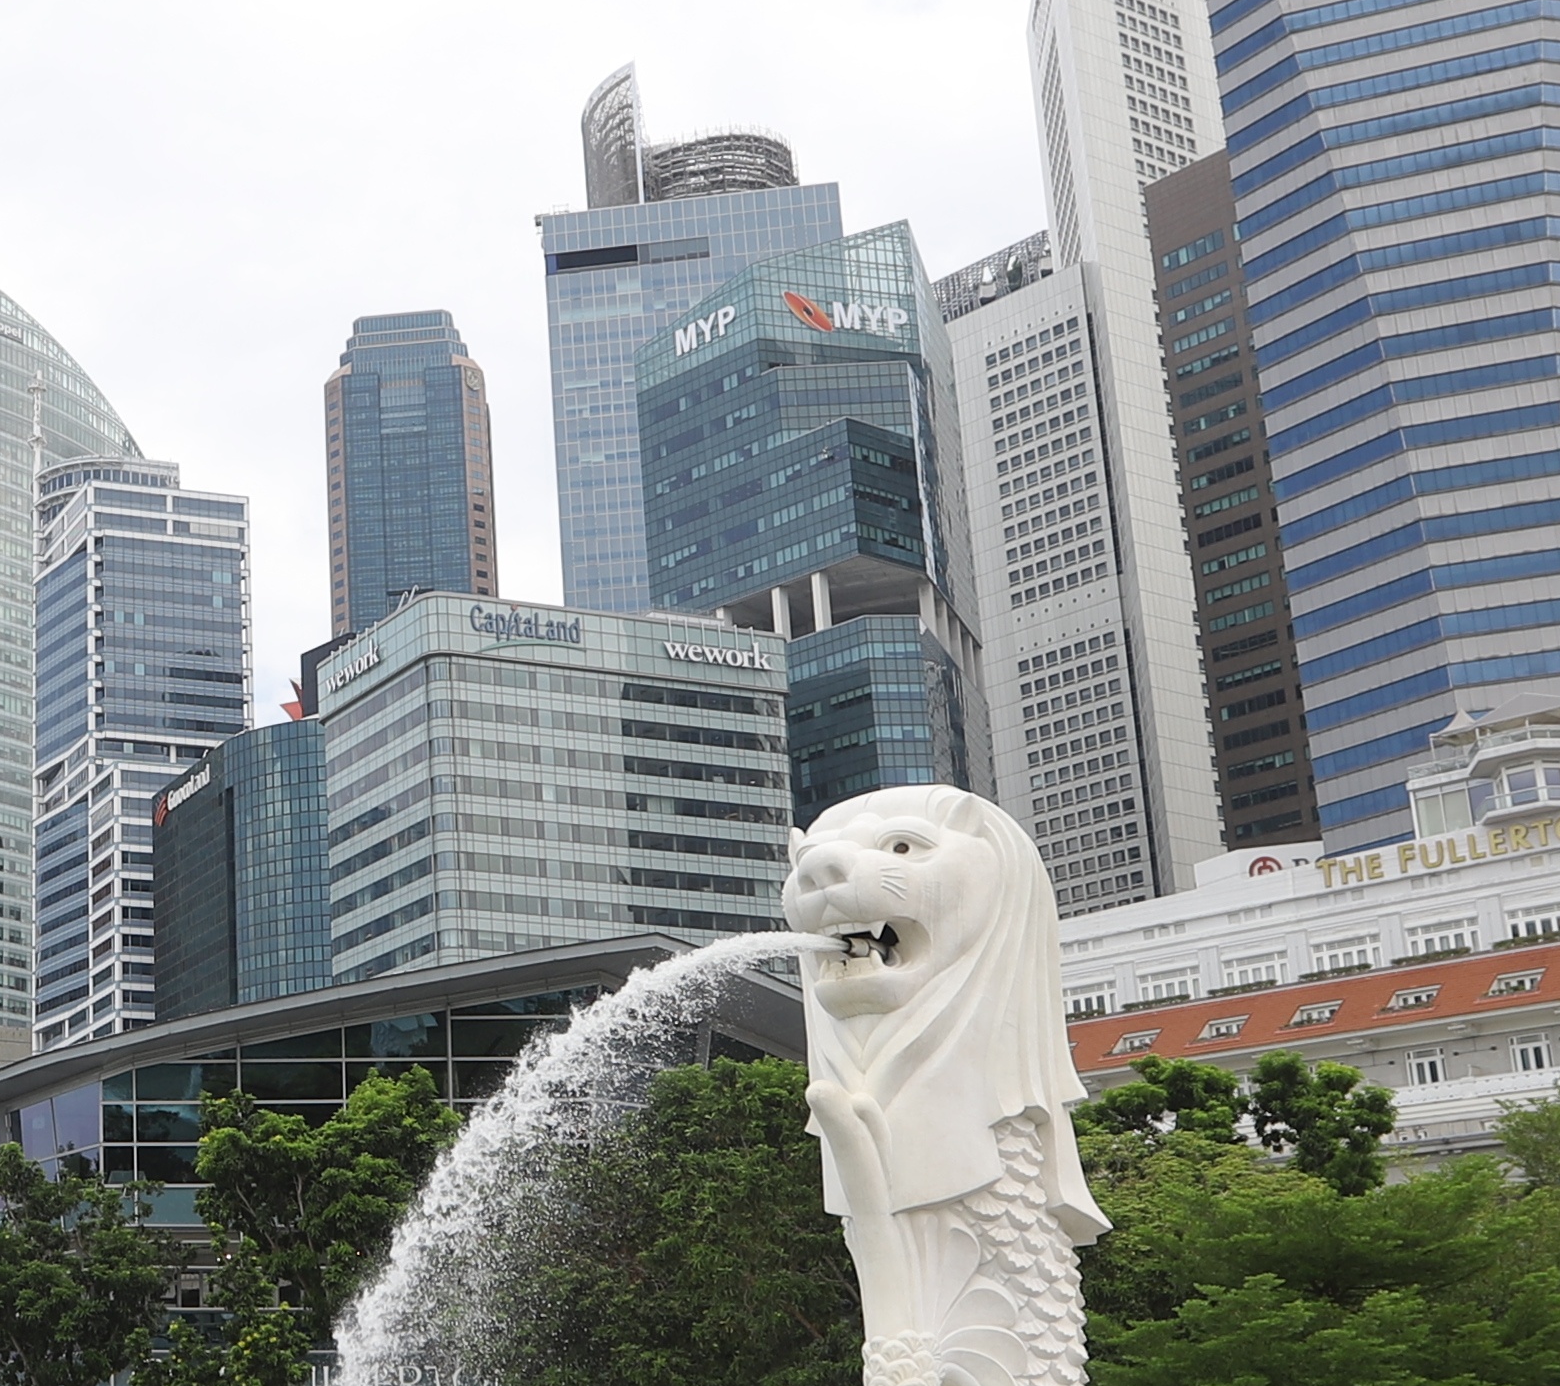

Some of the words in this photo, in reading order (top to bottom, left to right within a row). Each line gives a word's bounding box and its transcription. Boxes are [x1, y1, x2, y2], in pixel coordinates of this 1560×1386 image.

[675, 305, 736, 357] MYP
[832, 301, 909, 333] MYP
[469, 604, 581, 644] CapitaLand
[325, 639, 380, 693] wework
[663, 641, 773, 671] wework
[1315, 852, 1385, 888] THE
